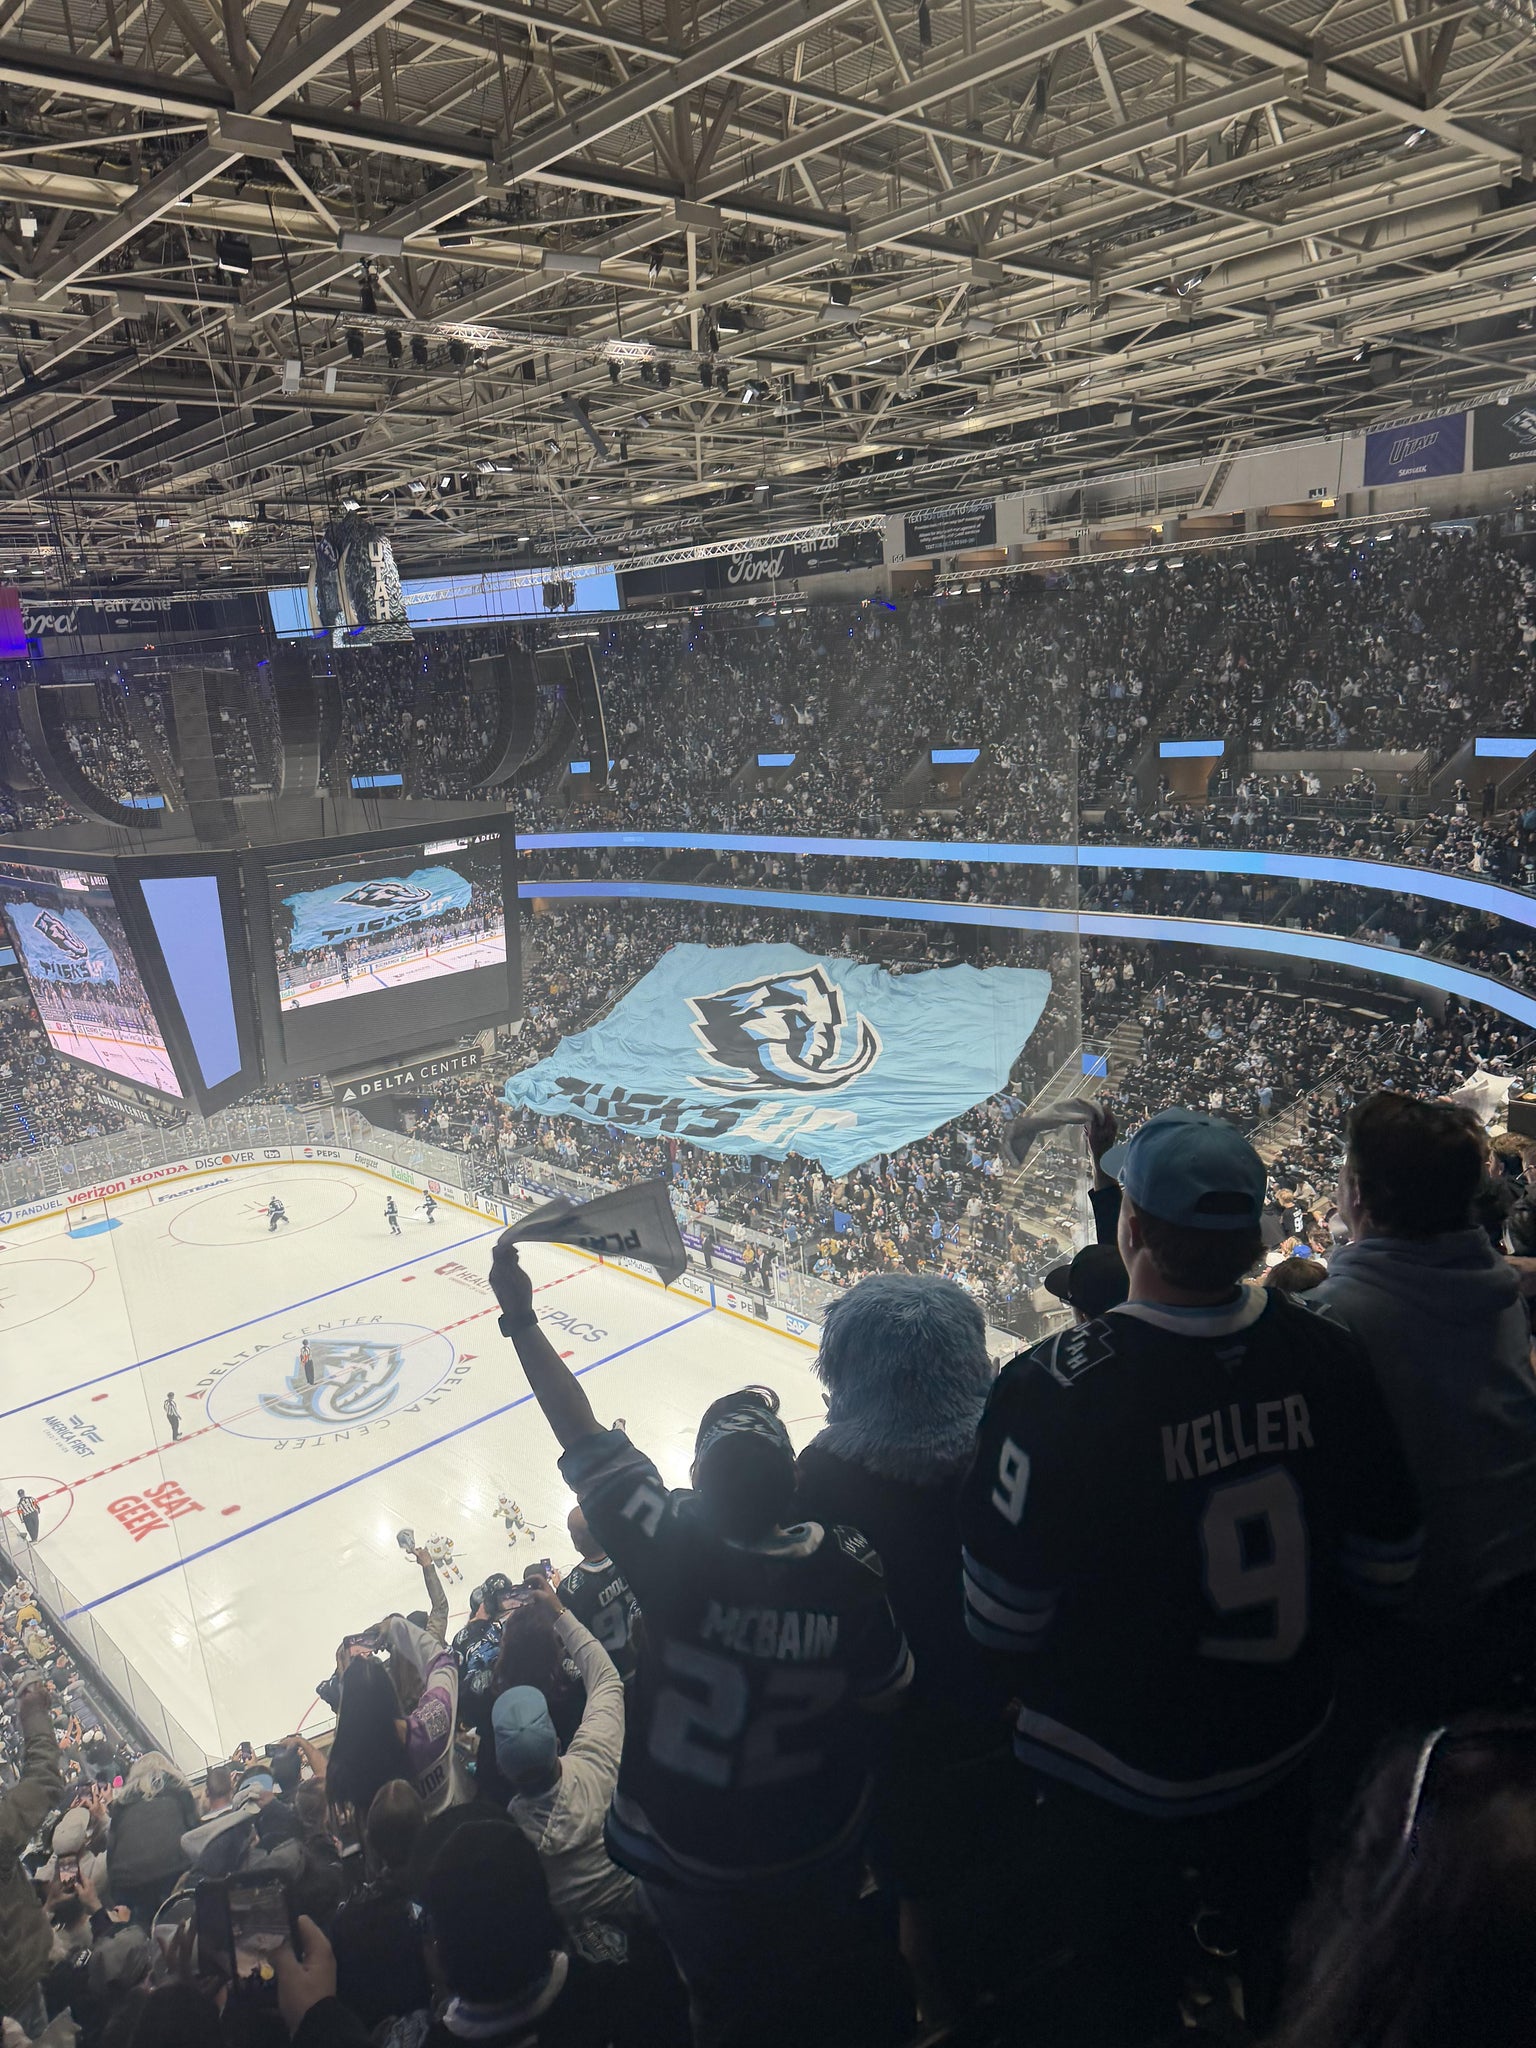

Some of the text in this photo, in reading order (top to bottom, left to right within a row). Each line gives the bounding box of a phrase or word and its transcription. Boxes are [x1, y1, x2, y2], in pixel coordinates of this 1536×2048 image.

[1389, 431, 1440, 466] UTAH
[1312, 487, 1325, 498] JJ
[1075, 528, 1089, 537] HH
[727, 549, 785, 585] Ford
[892, 554, 904, 563] GG
[368, 541, 391, 621] UTAH
[22, 606, 79, 635] ord
[361, 1053, 477, 1095] DELTA CENTER
[102, 1095, 151, 1123] DELTA CENTER
[195, 1151, 255, 1170] DISCOVER
[264, 1149, 281, 1159] tbs
[317, 1150, 341, 1159] PEPSI
[355, 1153, 379, 1170] Energizer
[130, 1164, 189, 1186] HONDA
[158, 1176, 233, 1202] FASTENAL
[67, 1181, 126, 1205] verizon
[16, 1199, 63, 1219] FANDUEL
[485, 1201, 499, 1217] CAT
[683, 1277, 704, 1294] Clips
[541, 1310, 608, 1342] PACS
[787, 1317, 806, 1334] SAP
[197, 1315, 383, 1387] DELTA CENTER
[274, 1366, 471, 1451] DELTA CENTER
[42, 1415, 76, 1442] AMERICA
[67, 1439, 95, 1458] FIRST
[1161, 1393, 1315, 1483] KELLER
[992, 1435, 1031, 1527] 9
[142, 1480, 206, 1520] SEAT
[106, 1495, 170, 1543] GEEK
[1197, 1463, 1309, 1663] 9
[598, 1577, 630, 1607] COOL
[591, 1600, 628, 1651] 9
[701, 1599, 839, 1661] MCBAIN
[648, 1637, 848, 1790] 22
